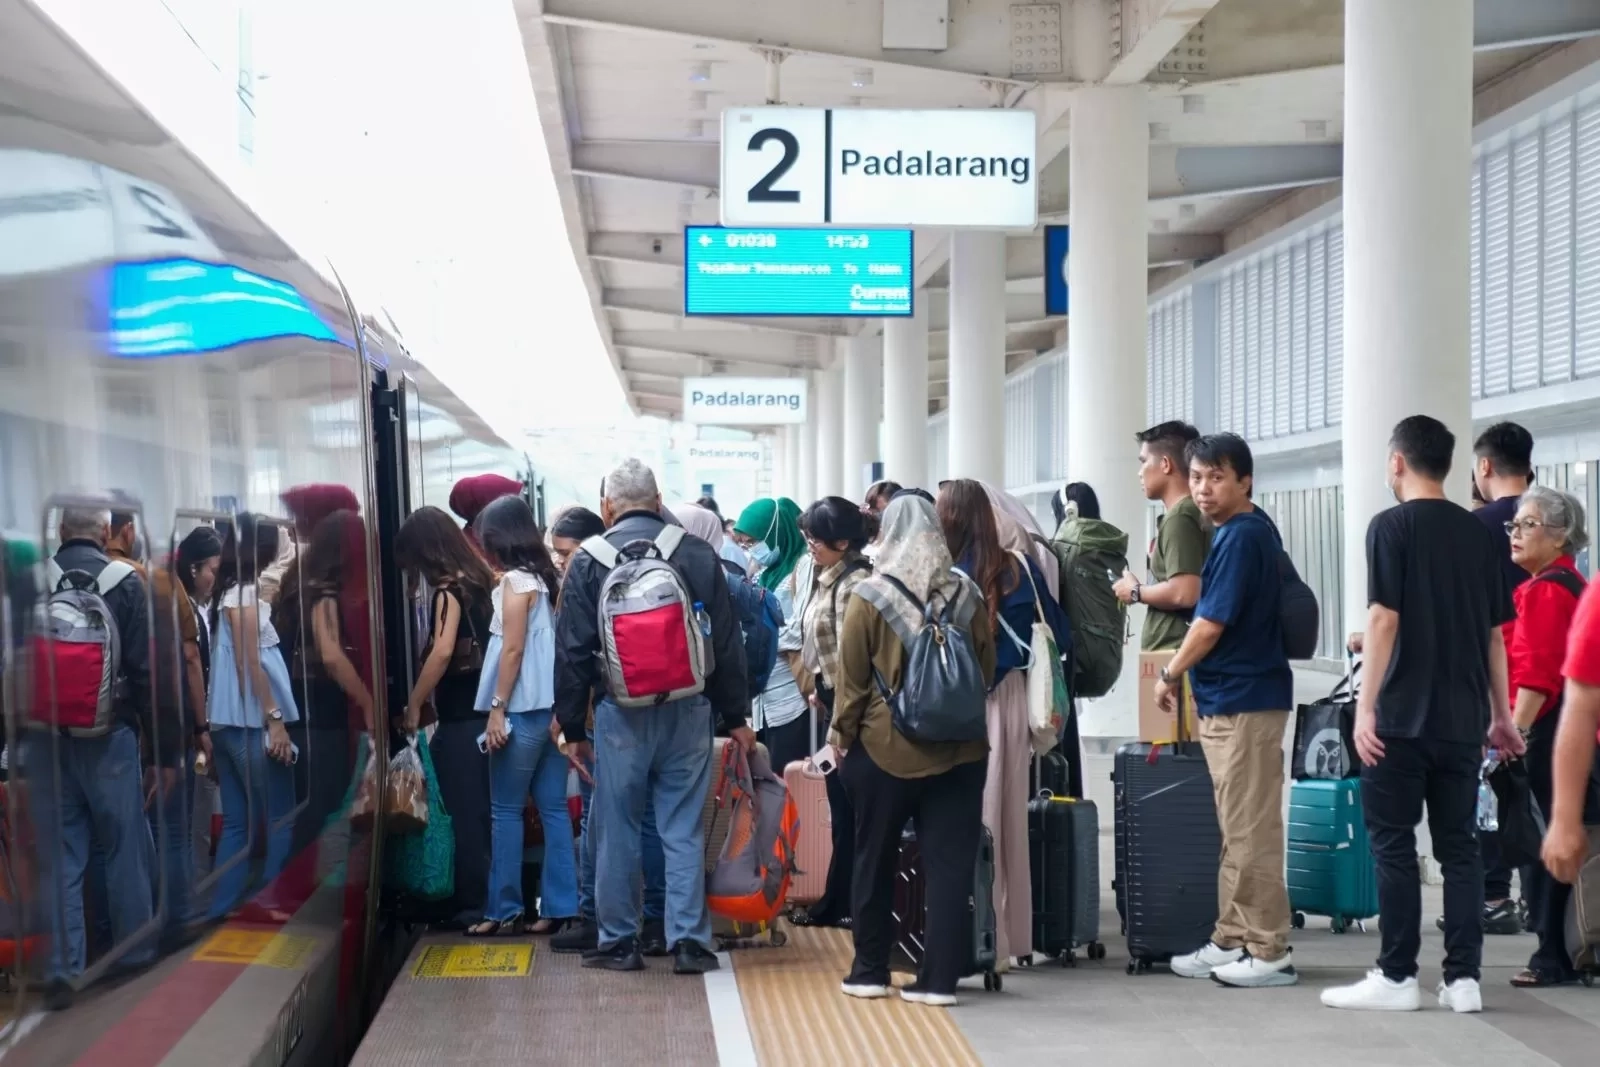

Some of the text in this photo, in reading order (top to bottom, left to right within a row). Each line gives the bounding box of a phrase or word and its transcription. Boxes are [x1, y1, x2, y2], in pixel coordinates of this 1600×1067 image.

[747, 127, 1031, 203] 2 Padalarang
[691, 390, 801, 411] Padalarang
[689, 447, 760, 461] Padalarang
